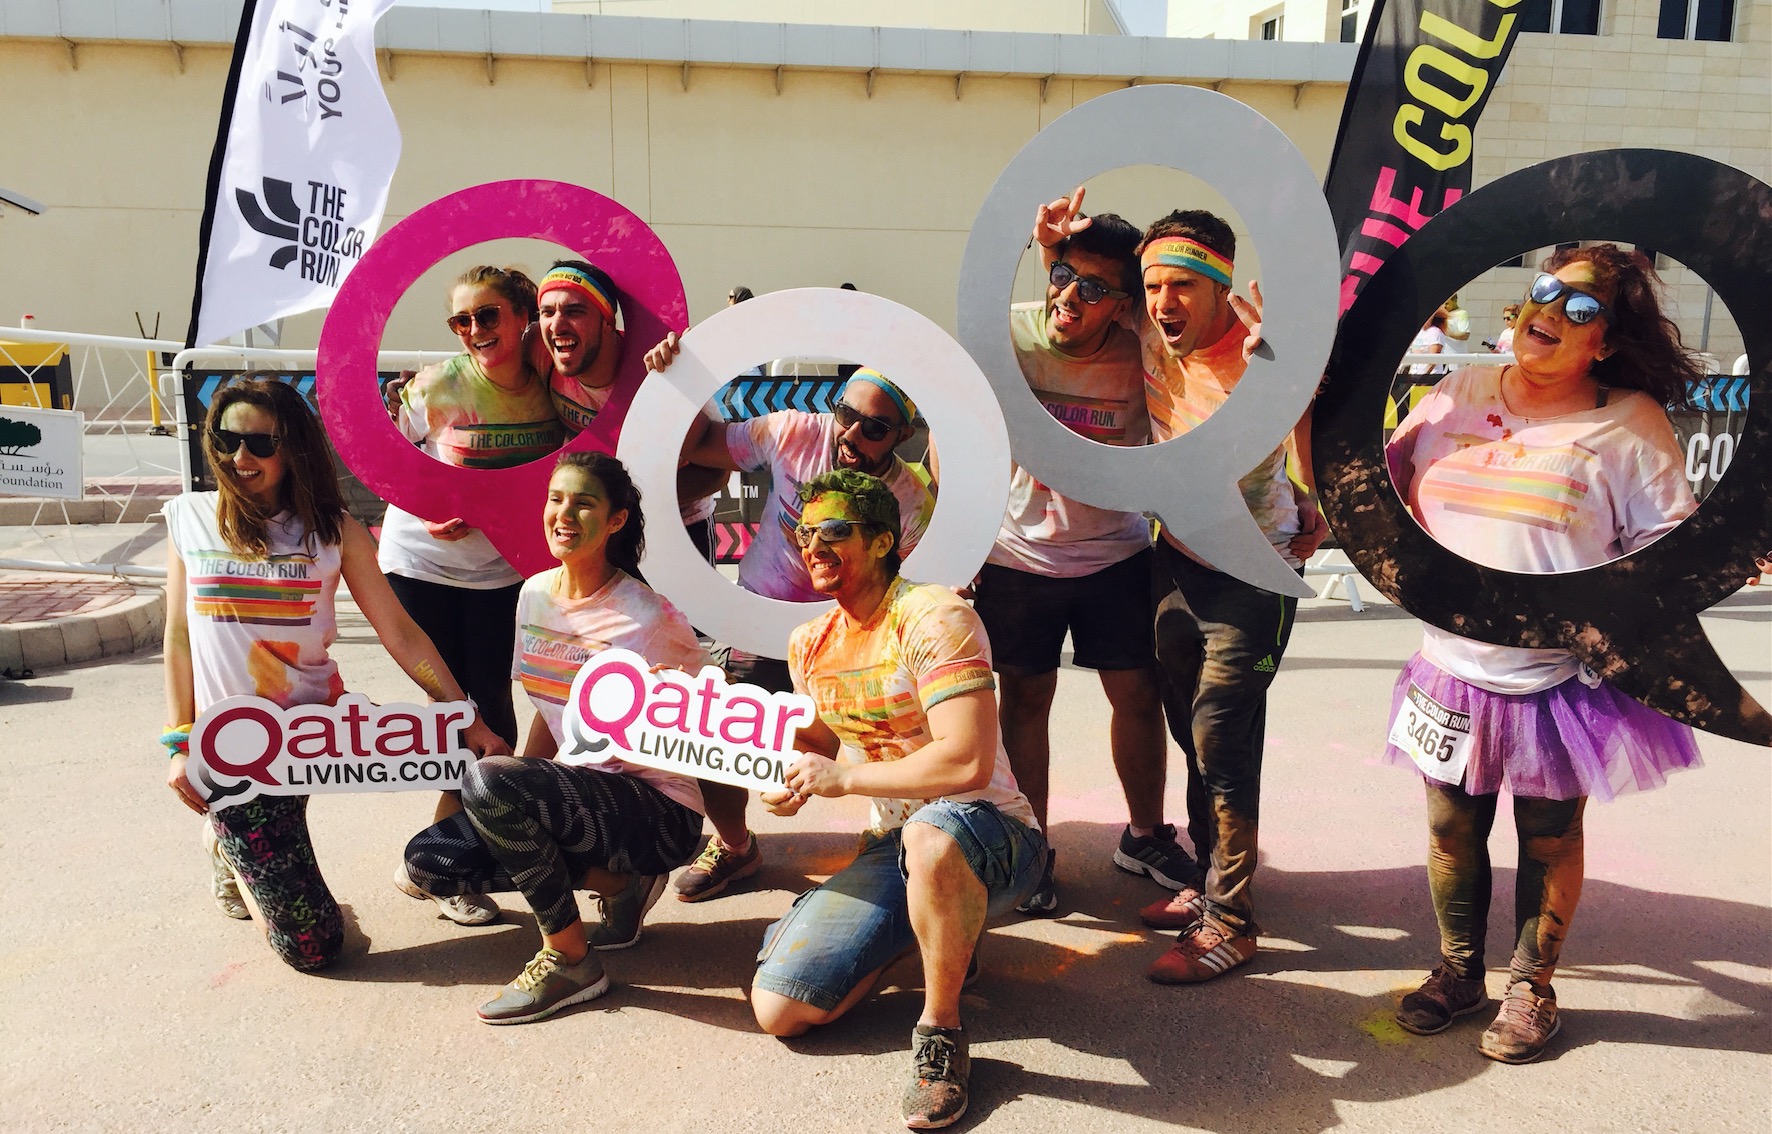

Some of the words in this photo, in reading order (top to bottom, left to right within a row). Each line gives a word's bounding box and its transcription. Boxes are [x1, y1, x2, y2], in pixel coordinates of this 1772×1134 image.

[1393, 0, 1522, 171] COL
[308, 180, 347, 222] THE
[302, 216, 365, 260] COLOR
[563, 403, 580, 424] THE
[469, 433, 492, 448] THE
[494, 432, 533, 448] COLOR
[1685, 432, 1742, 482] CO
[0, 475, 63, 489] oundation
[199, 559, 224, 575] THE
[225, 560, 274, 578] COLOR
[532, 638, 567, 660] COLOR
[579, 661, 805, 752] Qatar
[1423, 701, 1451, 725] COLOR
[201, 704, 465, 787] Qatar
[1407, 711, 1457, 762] 3465
[287, 759, 467, 786] LIVING.COM
